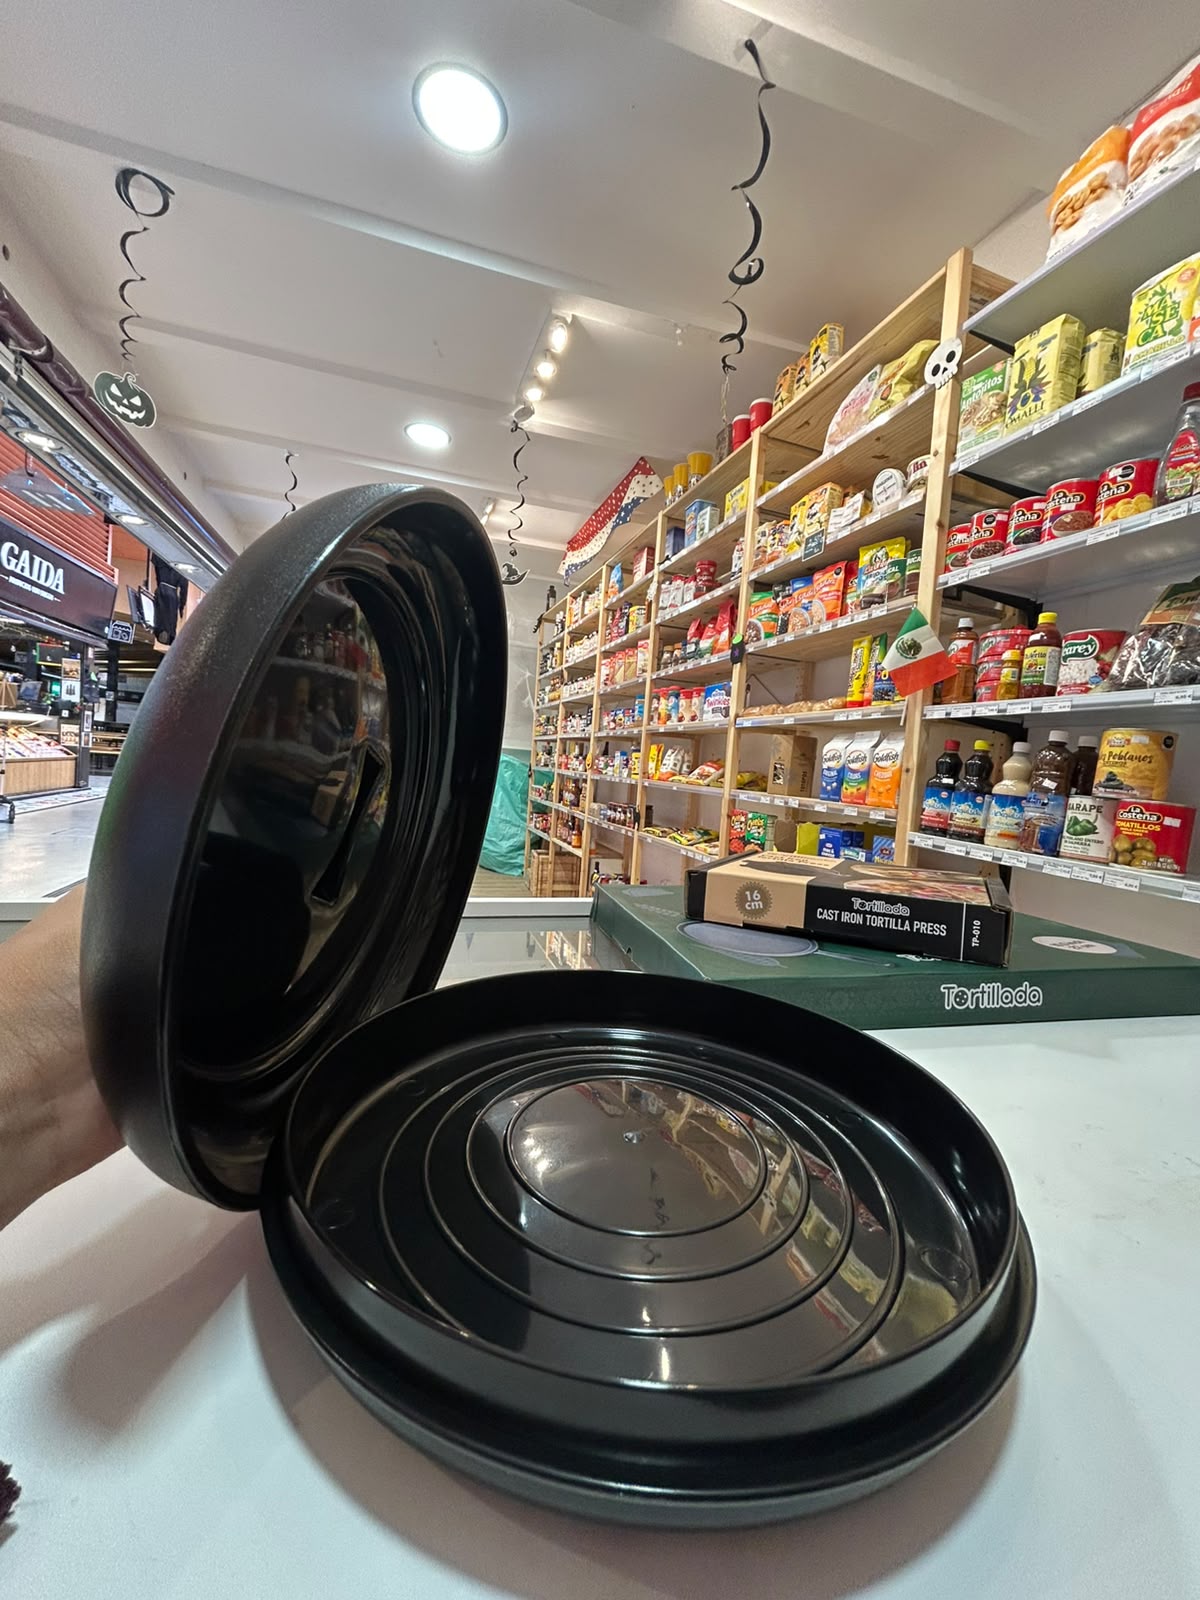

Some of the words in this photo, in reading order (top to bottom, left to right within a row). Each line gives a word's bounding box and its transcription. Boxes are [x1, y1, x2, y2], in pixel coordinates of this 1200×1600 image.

[0, 542, 65, 595] GAIDA
[873, 751, 900, 764] Goldfish
[744, 890, 761, 901] 16
[745, 901, 763, 910] cm
[851, 897, 910, 916] Tortillada
[816, 908, 839, 921] CAST
[841, 911, 863, 926] IRON
[866, 914, 911, 932] TORTILLA
[913, 920, 947, 937] PRESS
[971, 920, 981, 947] TP-010
[940, 981, 1043, 1010] Tortillada
